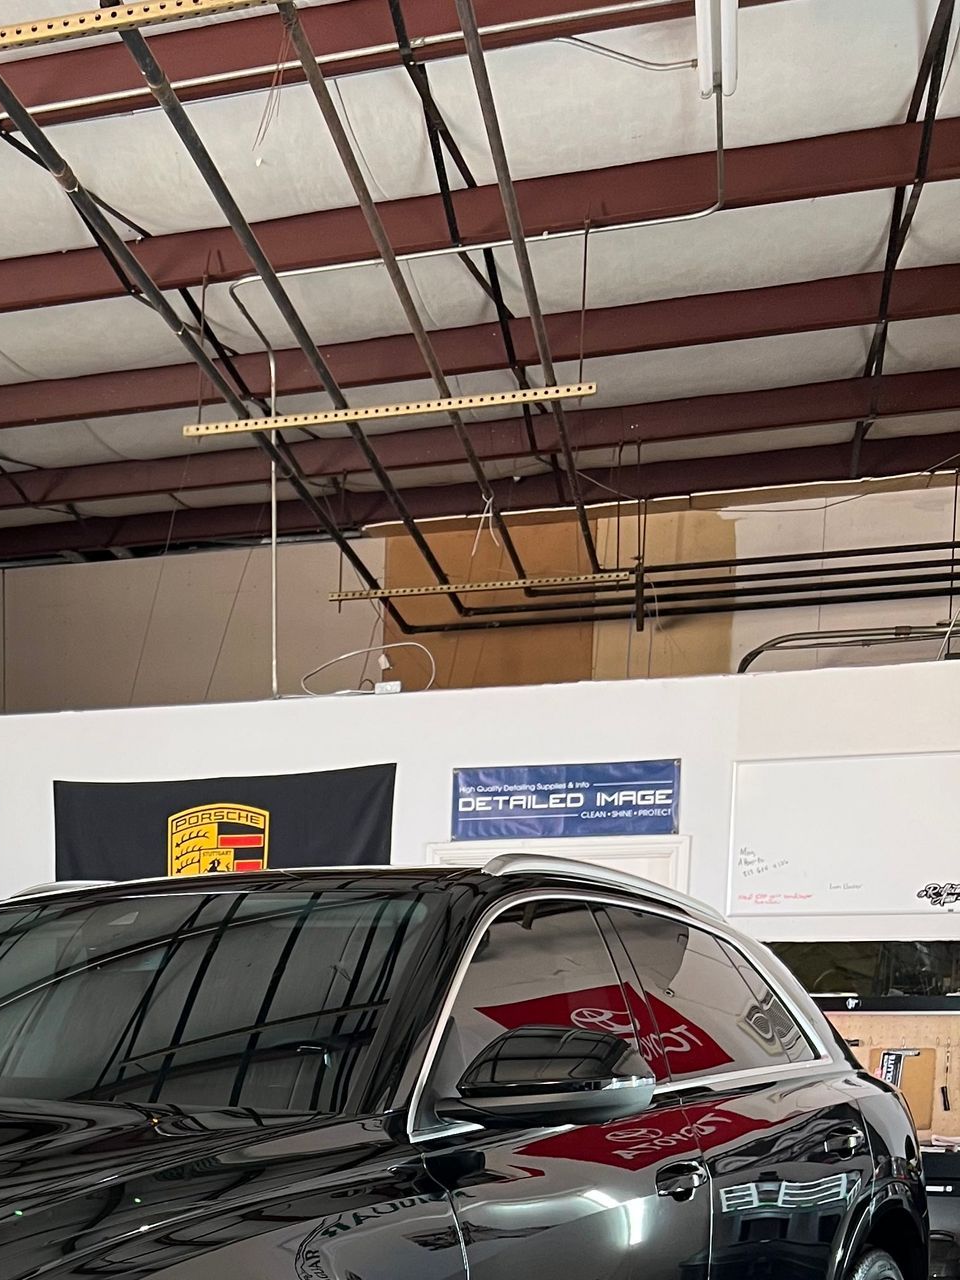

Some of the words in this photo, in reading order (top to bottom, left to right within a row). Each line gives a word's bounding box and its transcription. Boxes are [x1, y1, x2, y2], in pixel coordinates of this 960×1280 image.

[459, 785, 476, 794] High
[476, 784, 503, 793] Quality
[503, 783, 536, 792] Detailing
[536, 781, 567, 791] Supplies
[575, 781, 590, 789] Info
[458, 793, 585, 812] DETAILED
[596, 789, 674, 807] IMAGE
[175, 811, 261, 830] PORSCHE
[580, 811, 607, 819] CLEAN
[611, 809, 633, 818] SHINE
[637, 808, 672, 817] PROTECT
